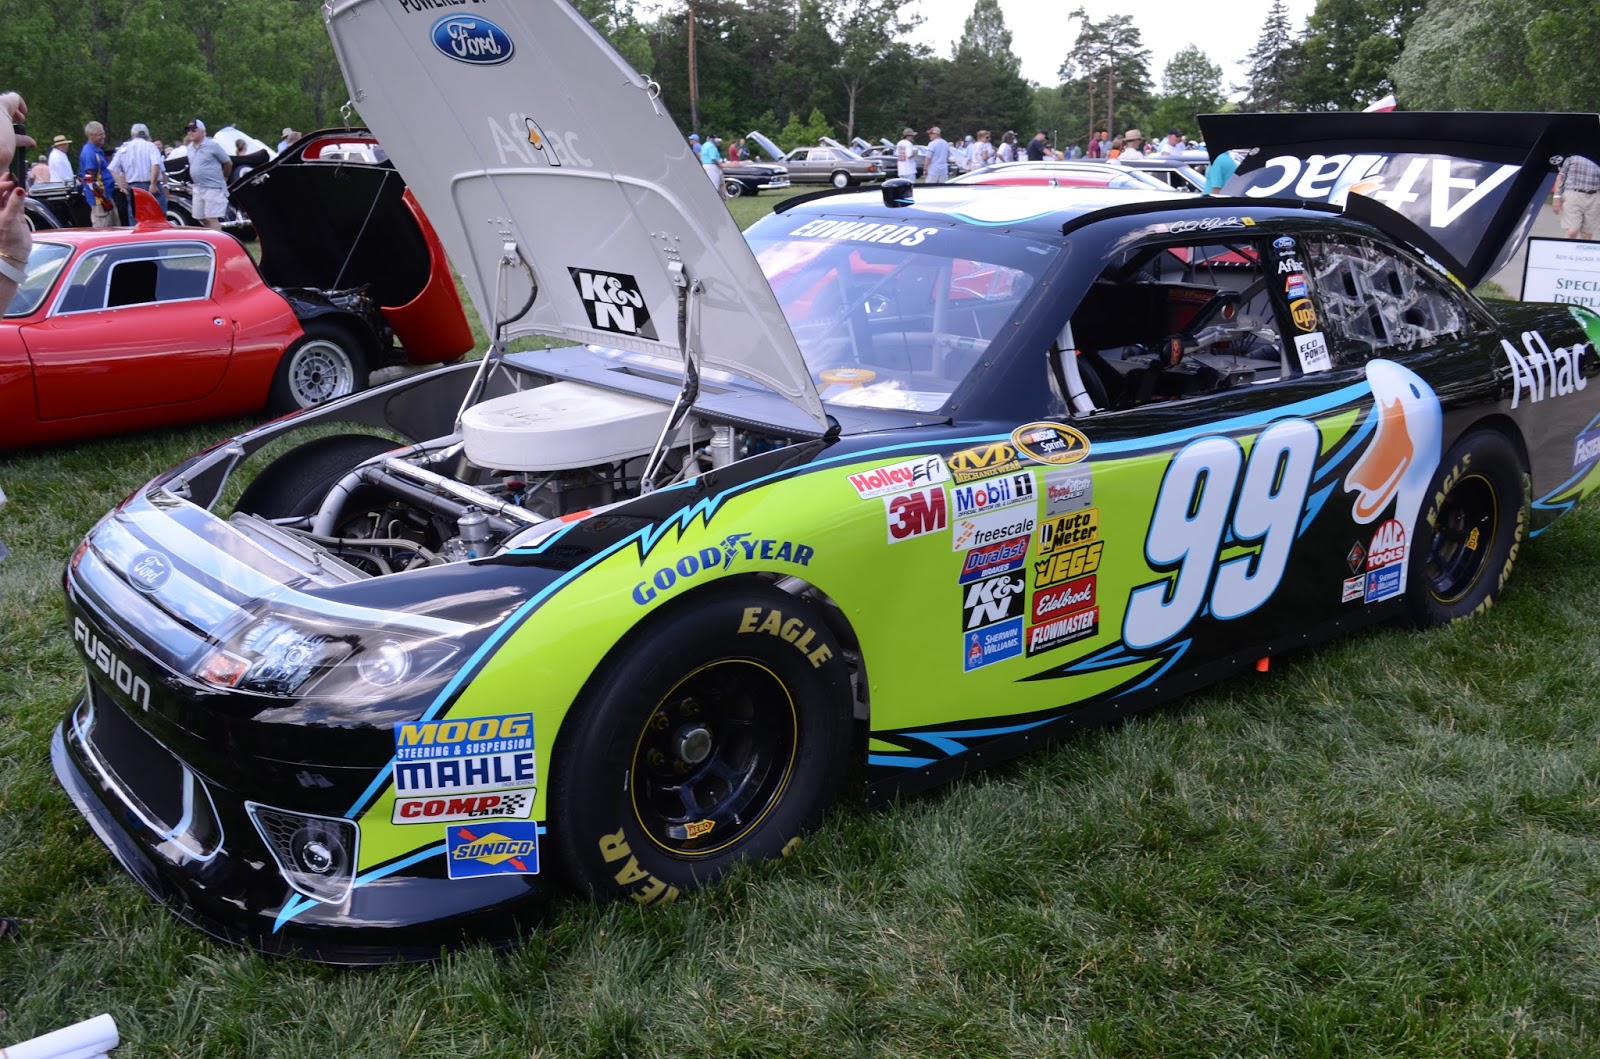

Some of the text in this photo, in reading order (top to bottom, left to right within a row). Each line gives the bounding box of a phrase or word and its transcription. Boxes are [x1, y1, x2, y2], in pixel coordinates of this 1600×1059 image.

[447, 22, 501, 57] Ford
[788, 219, 938, 246] EDWARDS
[1300, 339, 1318, 353] ECO
[1500, 330, 1588, 410] Aflac
[1040, 438, 1066, 452] Sprint
[849, 458, 938, 493] Holley EFI
[953, 460, 1023, 484] MECHANIX WEAR
[955, 477, 1010, 512] Mobil
[1427, 453, 1472, 529] EAGLE
[889, 486, 946, 539] 3M
[1055, 514, 1091, 534] Auto
[974, 518, 1034, 545] freescale
[1052, 526, 1097, 548] Meter
[1123, 418, 1321, 650] 99
[1368, 521, 1405, 557] MAC
[966, 541, 1026, 570] Duralast
[1034, 543, 1103, 588] JEGS
[1368, 547, 1404, 568] TOOLS
[134, 556, 164, 584] Ford
[980, 563, 1011, 578] BRAKES
[1036, 583, 1092, 616] Edelbrock
[738, 607, 833, 669] EAGLE
[984, 628, 1018, 645] SHERWIN
[1029, 611, 1095, 652] FLOWMASTER
[74, 617, 150, 712] FUSION
[397, 716, 531, 746] MOOG
[397, 738, 532, 759] STEERING & SUSPENSION
[396, 753, 534, 790] MAHLE
[400, 796, 501, 818] COMP
[468, 807, 516, 817] CAMS
[689, 822, 710, 835] AERO
[457, 842, 530, 858] SUNOCO
